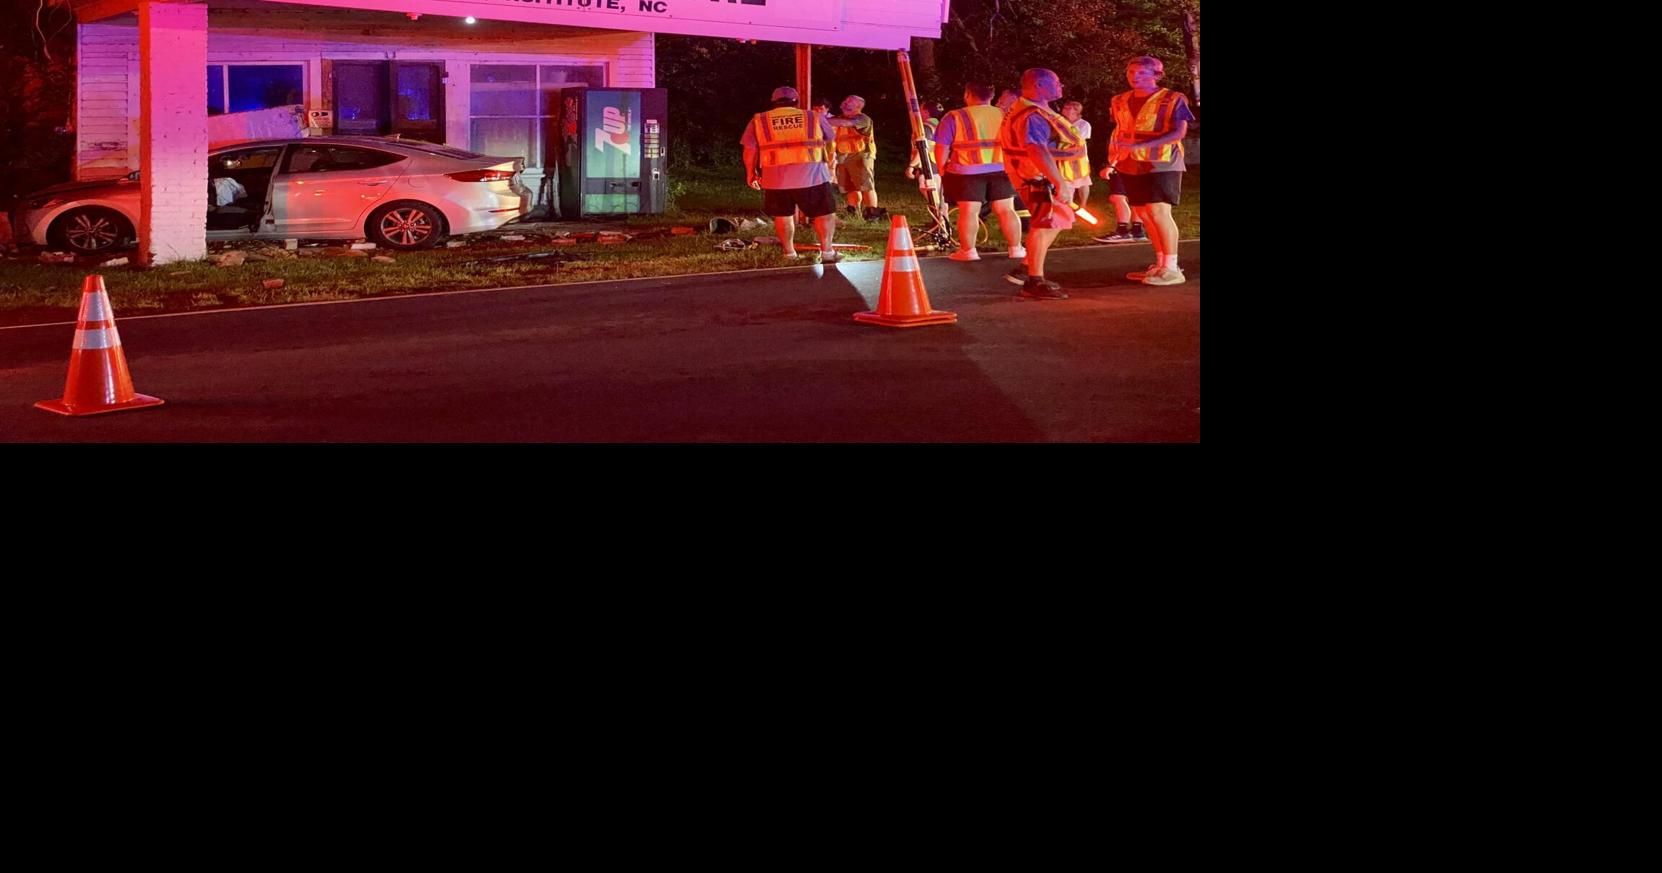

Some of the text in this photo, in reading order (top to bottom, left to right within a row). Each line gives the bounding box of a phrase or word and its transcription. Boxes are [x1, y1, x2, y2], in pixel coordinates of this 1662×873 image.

[639, 0, 667, 13] NC
[772, 116, 803, 126] FIRE
[773, 123, 803, 131] RESCUE
